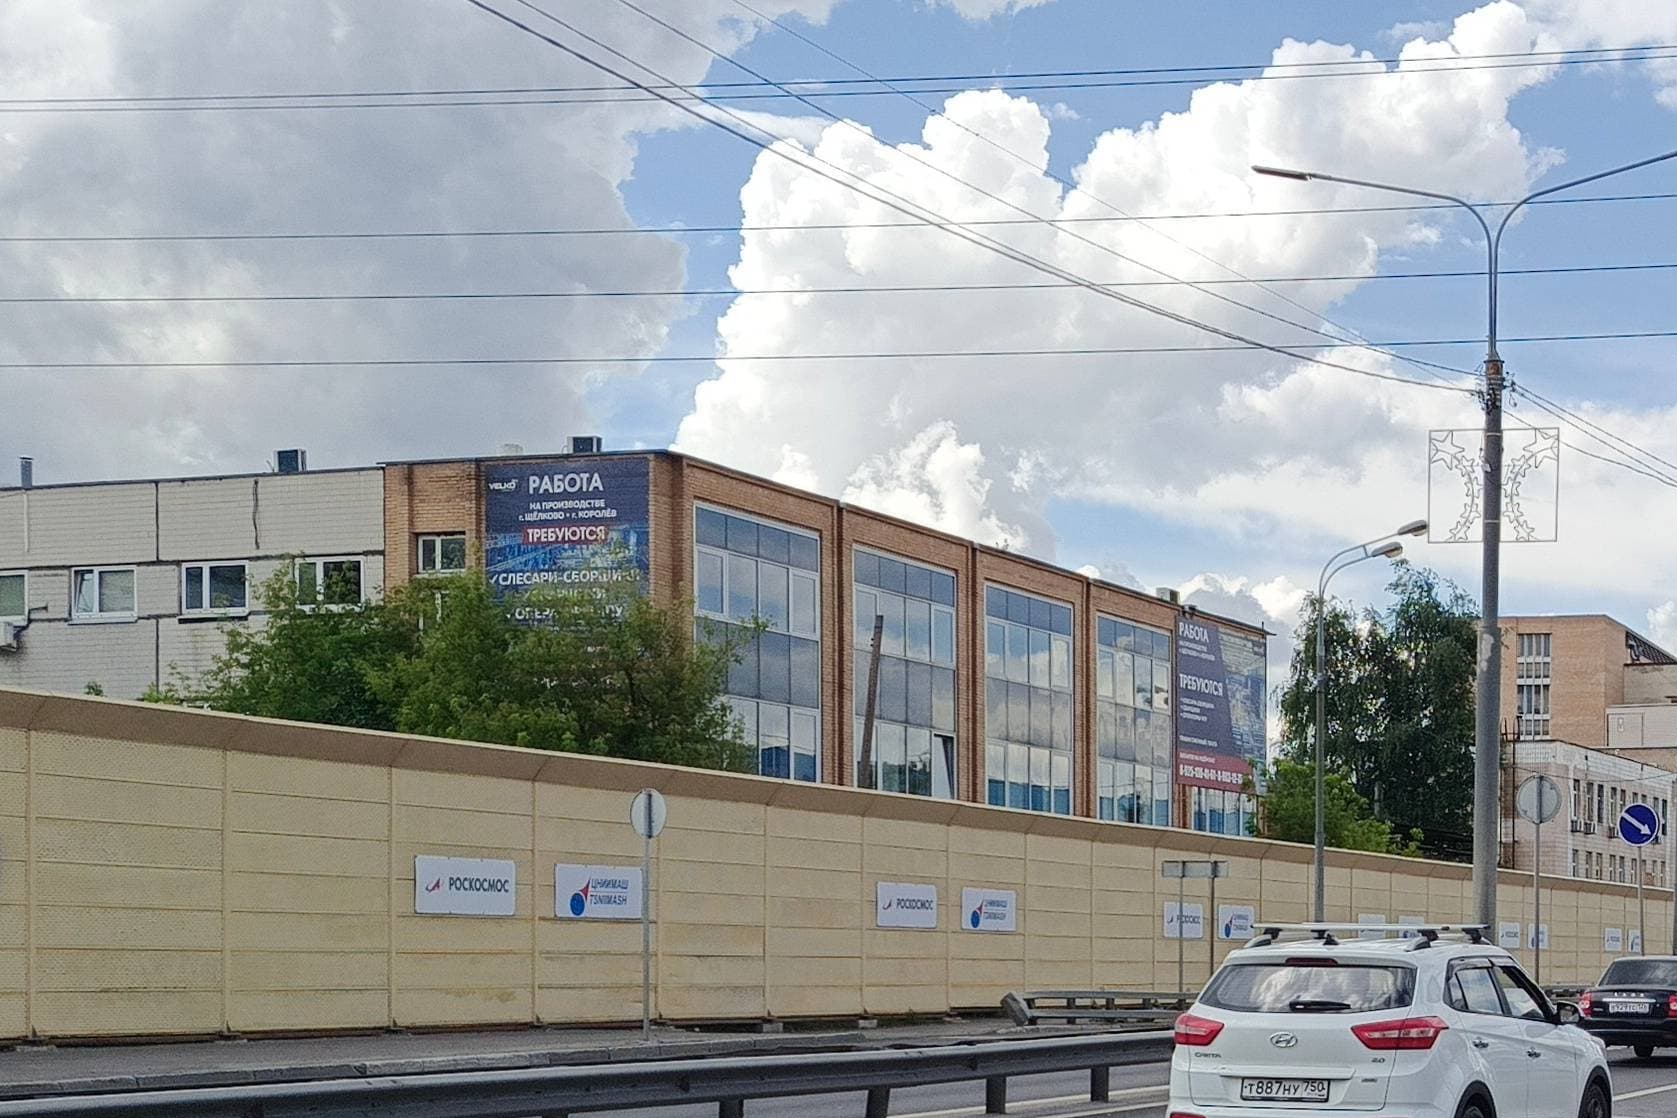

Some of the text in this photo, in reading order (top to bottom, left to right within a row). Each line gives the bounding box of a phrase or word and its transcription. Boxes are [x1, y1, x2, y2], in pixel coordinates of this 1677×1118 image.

[528, 472, 604, 494] РАБОТА
[529, 499, 606, 510] НА ПРОИЗВОДСТВЕ
[525, 510, 565, 521] ЩЁЛКОВО
[578, 508, 617, 519] КОРОЛЁВ
[526, 525, 607, 543] ТРЕБУЮТСЯ
[498, 568, 641, 586] СЛЕСАРИ-СБОРЩИ
[1179, 621, 1209, 643] РАБОТА
[1179, 673, 1223, 696] ТРЕБУЮТСЯ
[448, 876, 510, 893] РОСКОСМОС
[590, 879, 630, 891] ЦНИИМАШ
[1247, 1080, 1325, 1096] Т887НУ 750
